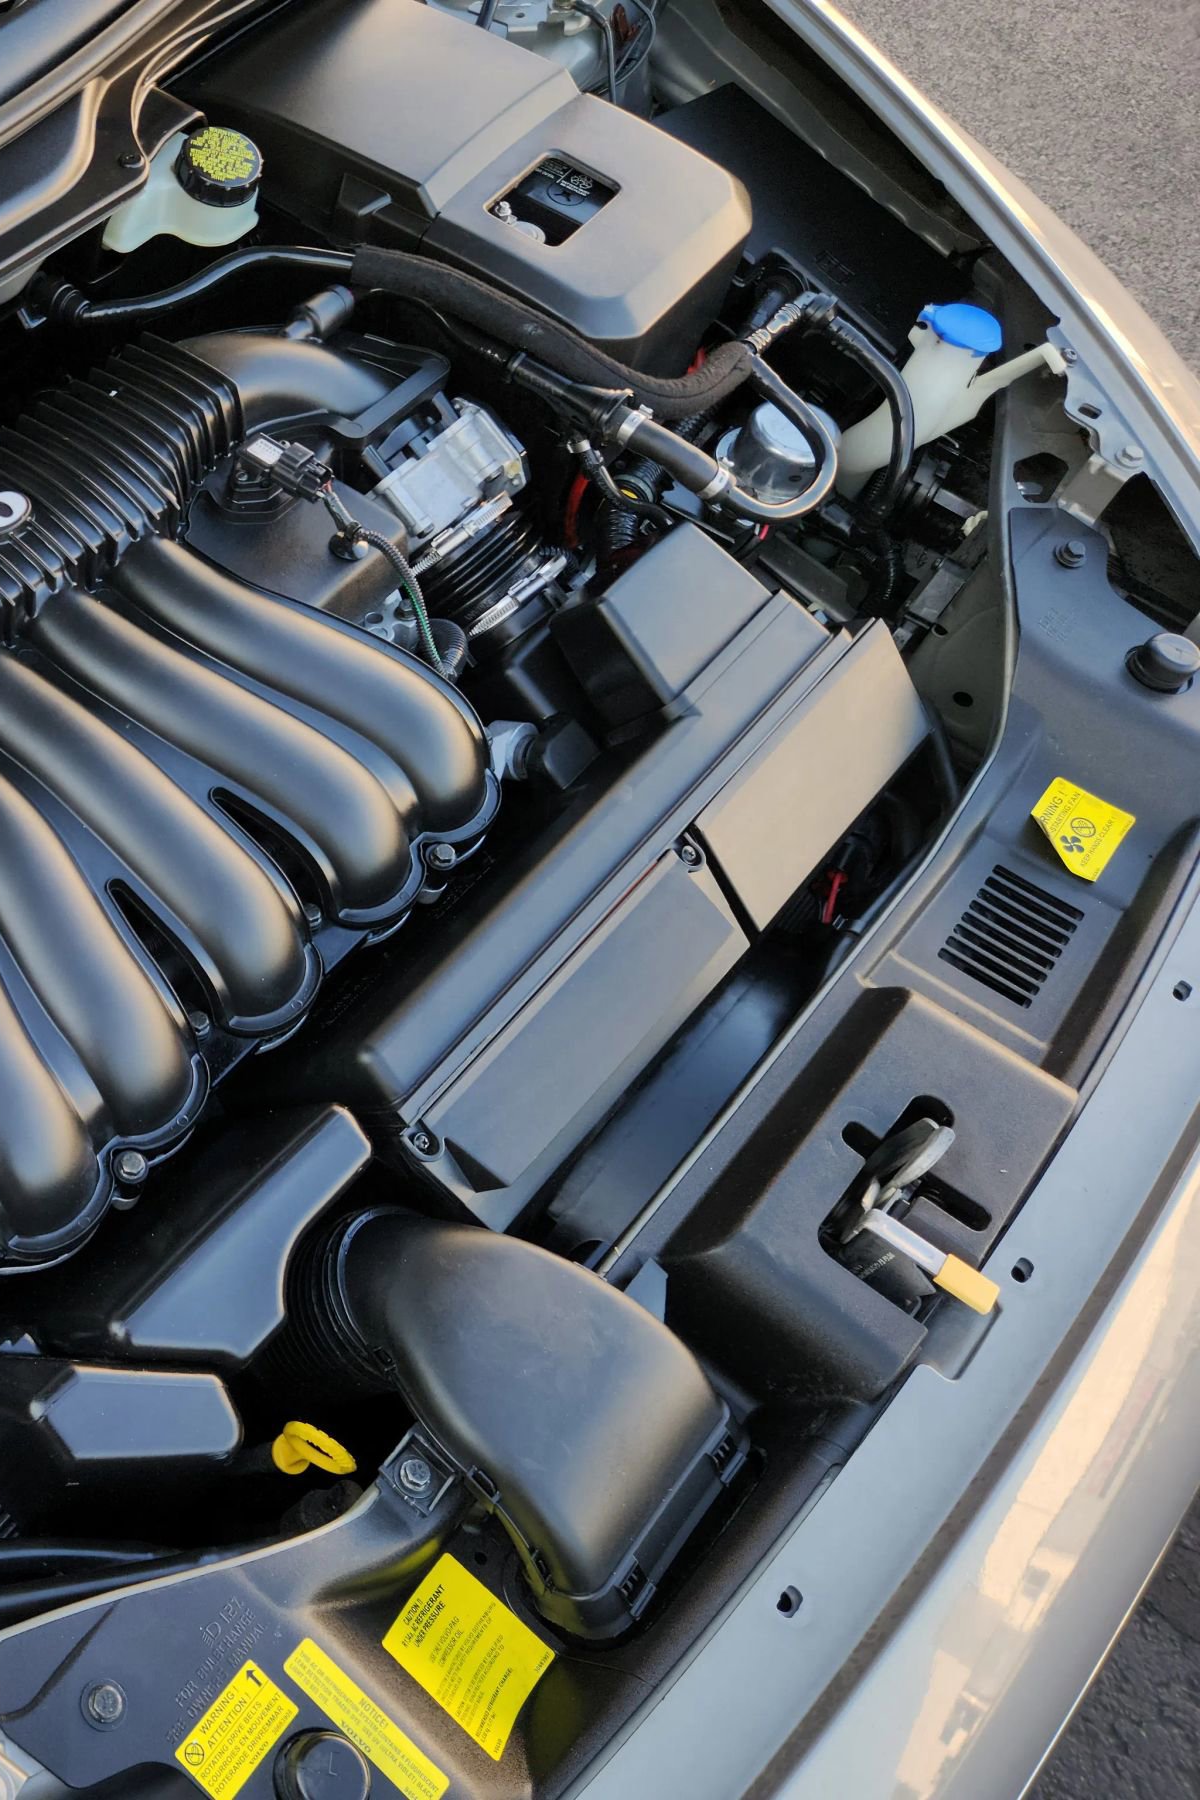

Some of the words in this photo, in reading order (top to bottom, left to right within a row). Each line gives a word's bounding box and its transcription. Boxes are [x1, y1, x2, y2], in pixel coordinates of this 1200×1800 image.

[1040, 796, 1063, 825] RNING
[402, 1602, 419, 1625] CAUTION
[412, 1628, 426, 1647] UNDER
[422, 1600, 445, 1632] PRESSURE
[414, 1583, 445, 1626] REFRIGERANT
[175, 1680, 199, 1708] FOR
[199, 1691, 236, 1735] WARNING
[357, 1697, 389, 1729] NOTICE!
[200, 1745, 229, 1780] ROTATING
[228, 1726, 245, 1746] DRIVE
[243, 1701, 262, 1724] BELTS
[207, 1698, 248, 1749] ATTENTION
[207, 1747, 241, 1787] COURROIES
[239, 1734, 249, 1746] EN
[247, 1692, 281, 1736] MOUVEMENT
[338, 1719, 372, 1753] VOLVO
[214, 1753, 249, 1795] ROTERANDE
[247, 1706, 284, 1752] DRIVREMMAR
[249, 1741, 269, 1766] VOLVO
